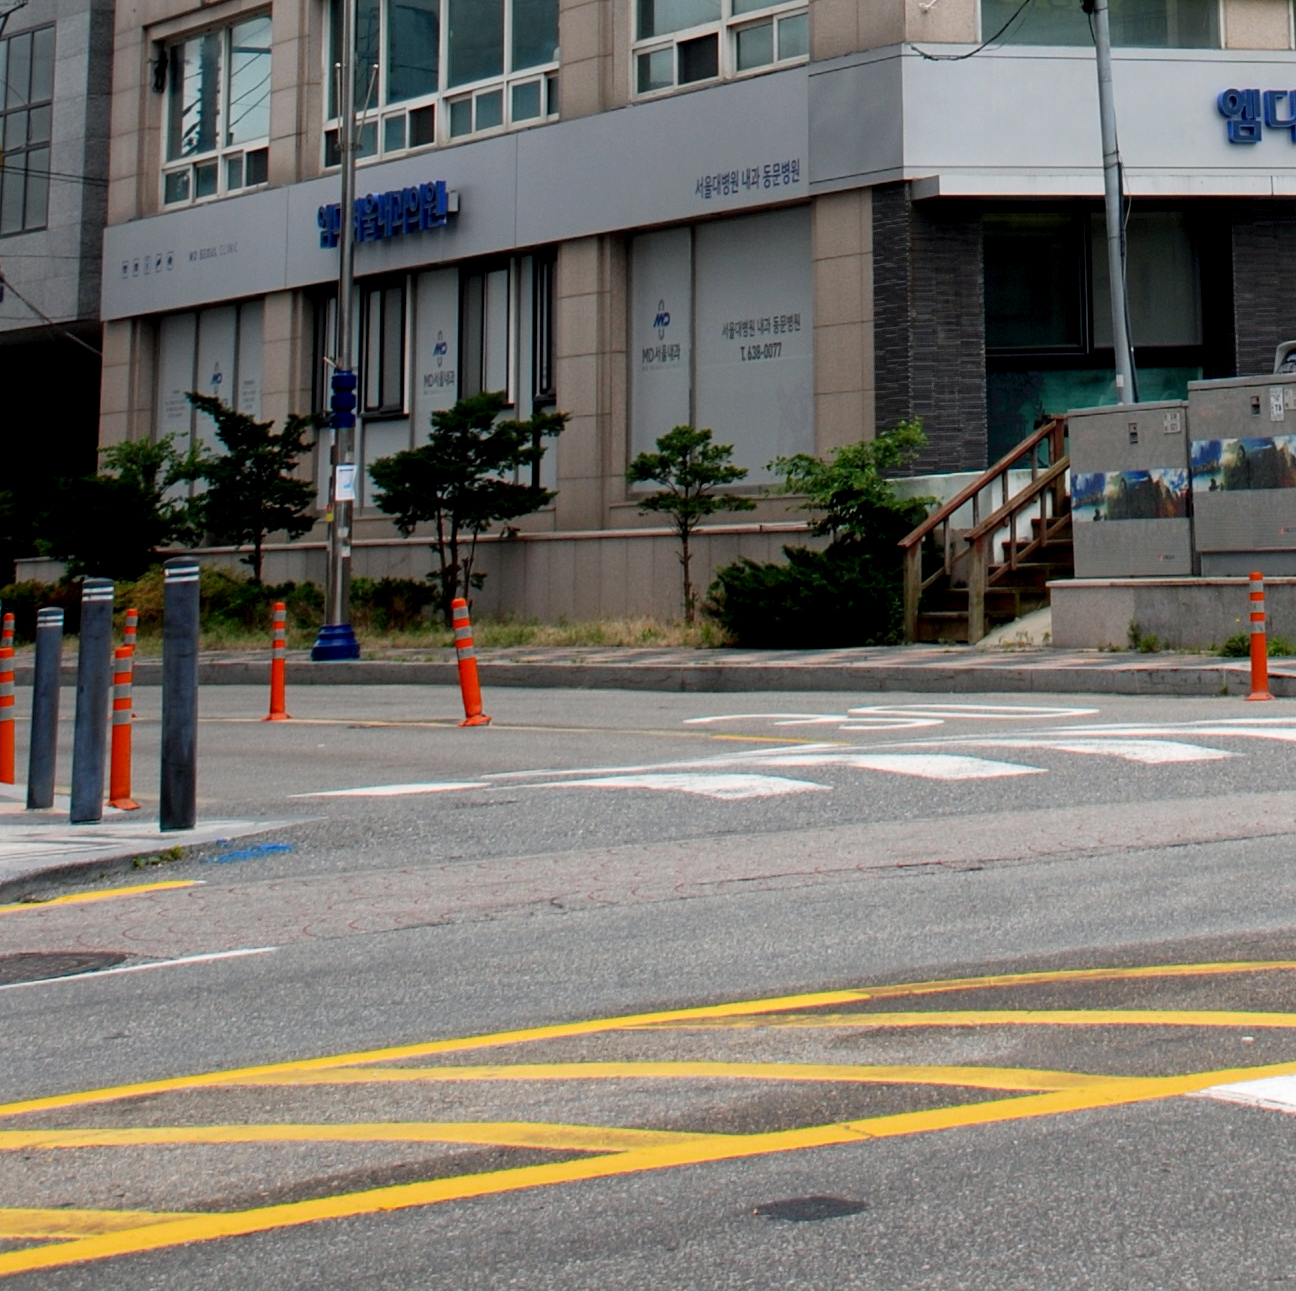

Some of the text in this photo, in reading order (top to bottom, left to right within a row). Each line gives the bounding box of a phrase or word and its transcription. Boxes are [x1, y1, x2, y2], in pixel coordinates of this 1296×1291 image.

[695, 158, 800, 199] 서울대병원 내과 동문병원
